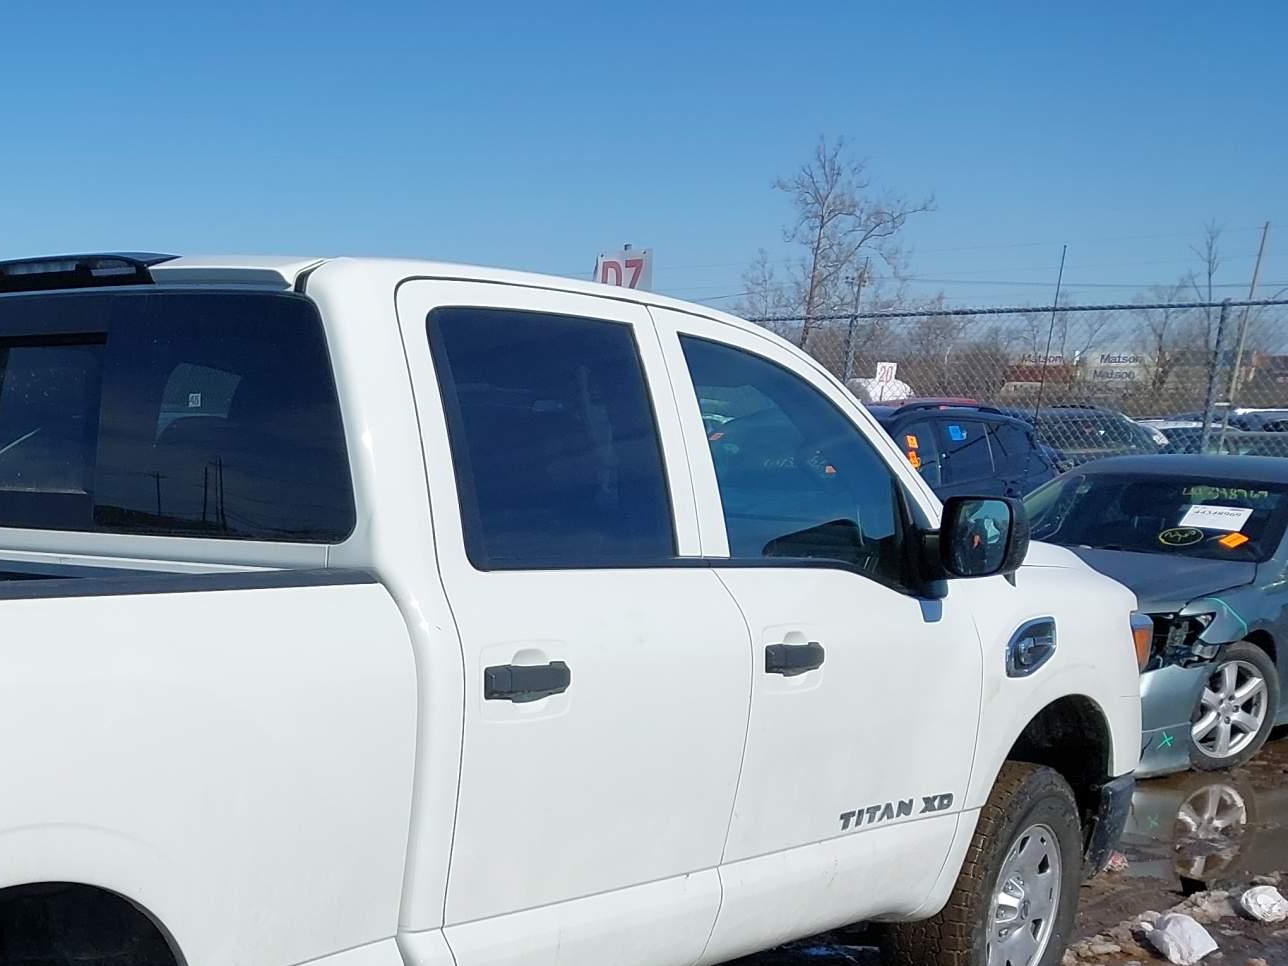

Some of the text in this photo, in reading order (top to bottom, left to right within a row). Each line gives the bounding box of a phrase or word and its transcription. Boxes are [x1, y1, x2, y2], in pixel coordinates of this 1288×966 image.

[1099, 352, 1144, 364] Matson
[839, 792, 954, 831] TITAN XD
